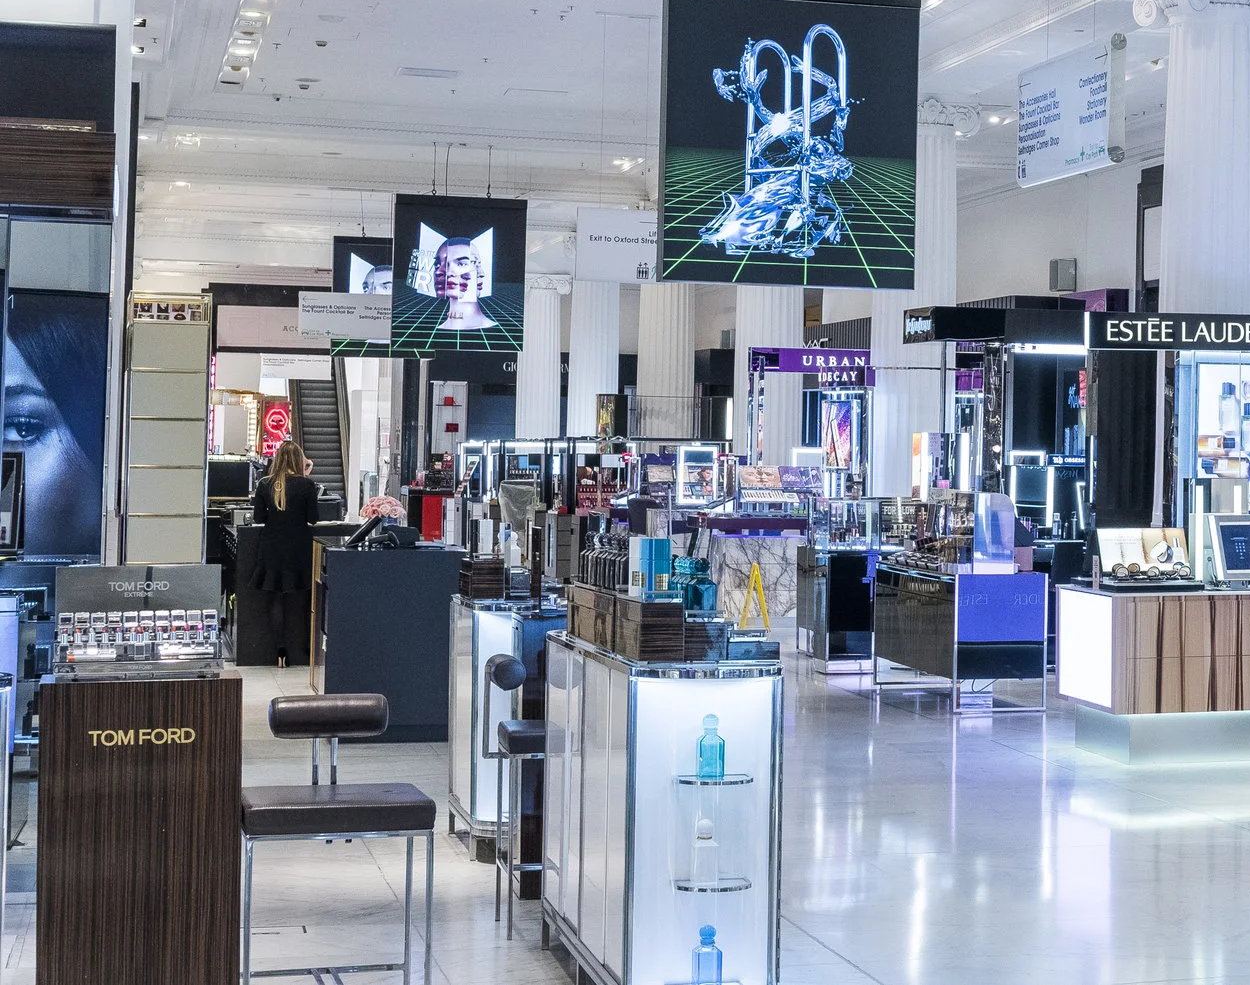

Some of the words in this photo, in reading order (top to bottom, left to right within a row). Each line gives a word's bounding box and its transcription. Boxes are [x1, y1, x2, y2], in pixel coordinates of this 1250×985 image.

[614, 236, 639, 244] Oxford
[802, 355, 865, 366] URBAN
[818, 371, 857, 382] DECAY
[108, 581, 135, 591] TOM
[137, 581, 170, 591] FORD
[88, 729, 134, 746] TOM
[139, 727, 196, 745] FORD
